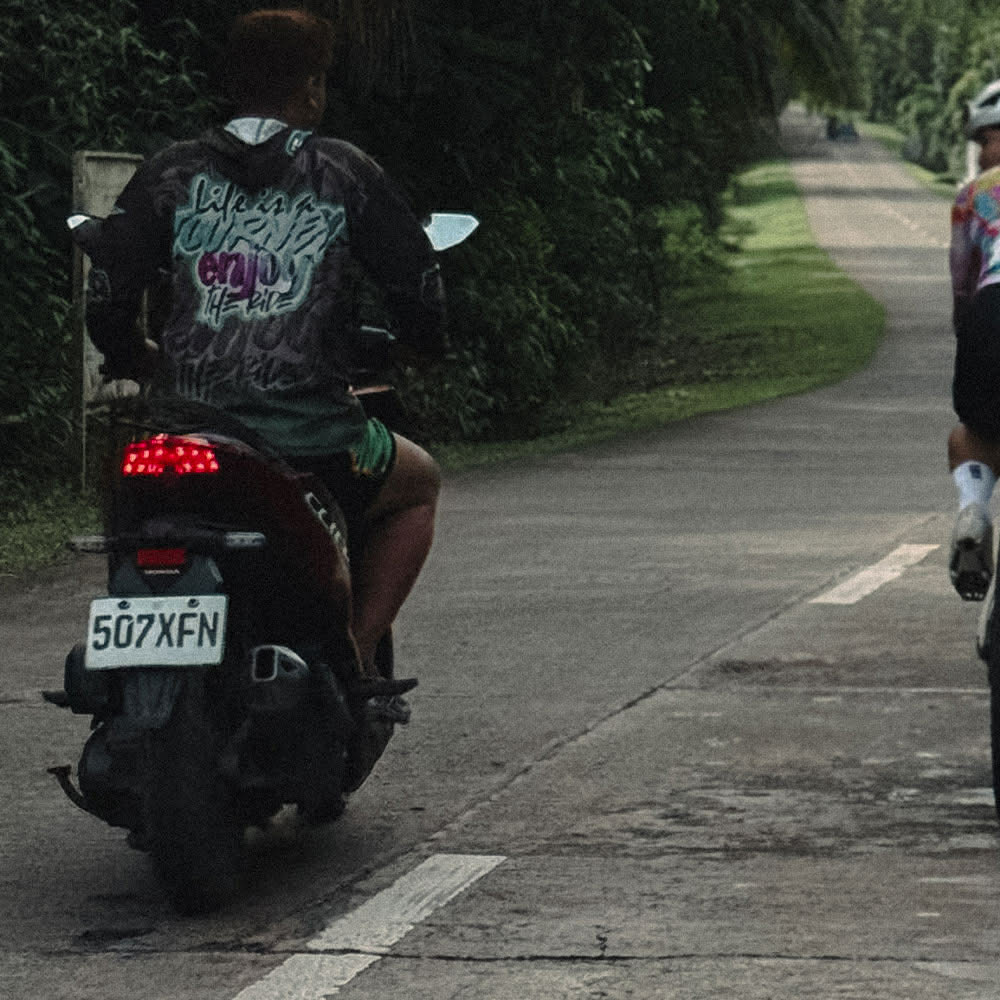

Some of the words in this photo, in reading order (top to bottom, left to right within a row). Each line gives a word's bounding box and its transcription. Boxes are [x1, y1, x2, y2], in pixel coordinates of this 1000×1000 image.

[195, 178, 246, 222] Life
[257, 190, 285, 215] is
[198, 246, 313, 301] enjoy
[92, 612, 219, 650] 507XFN
